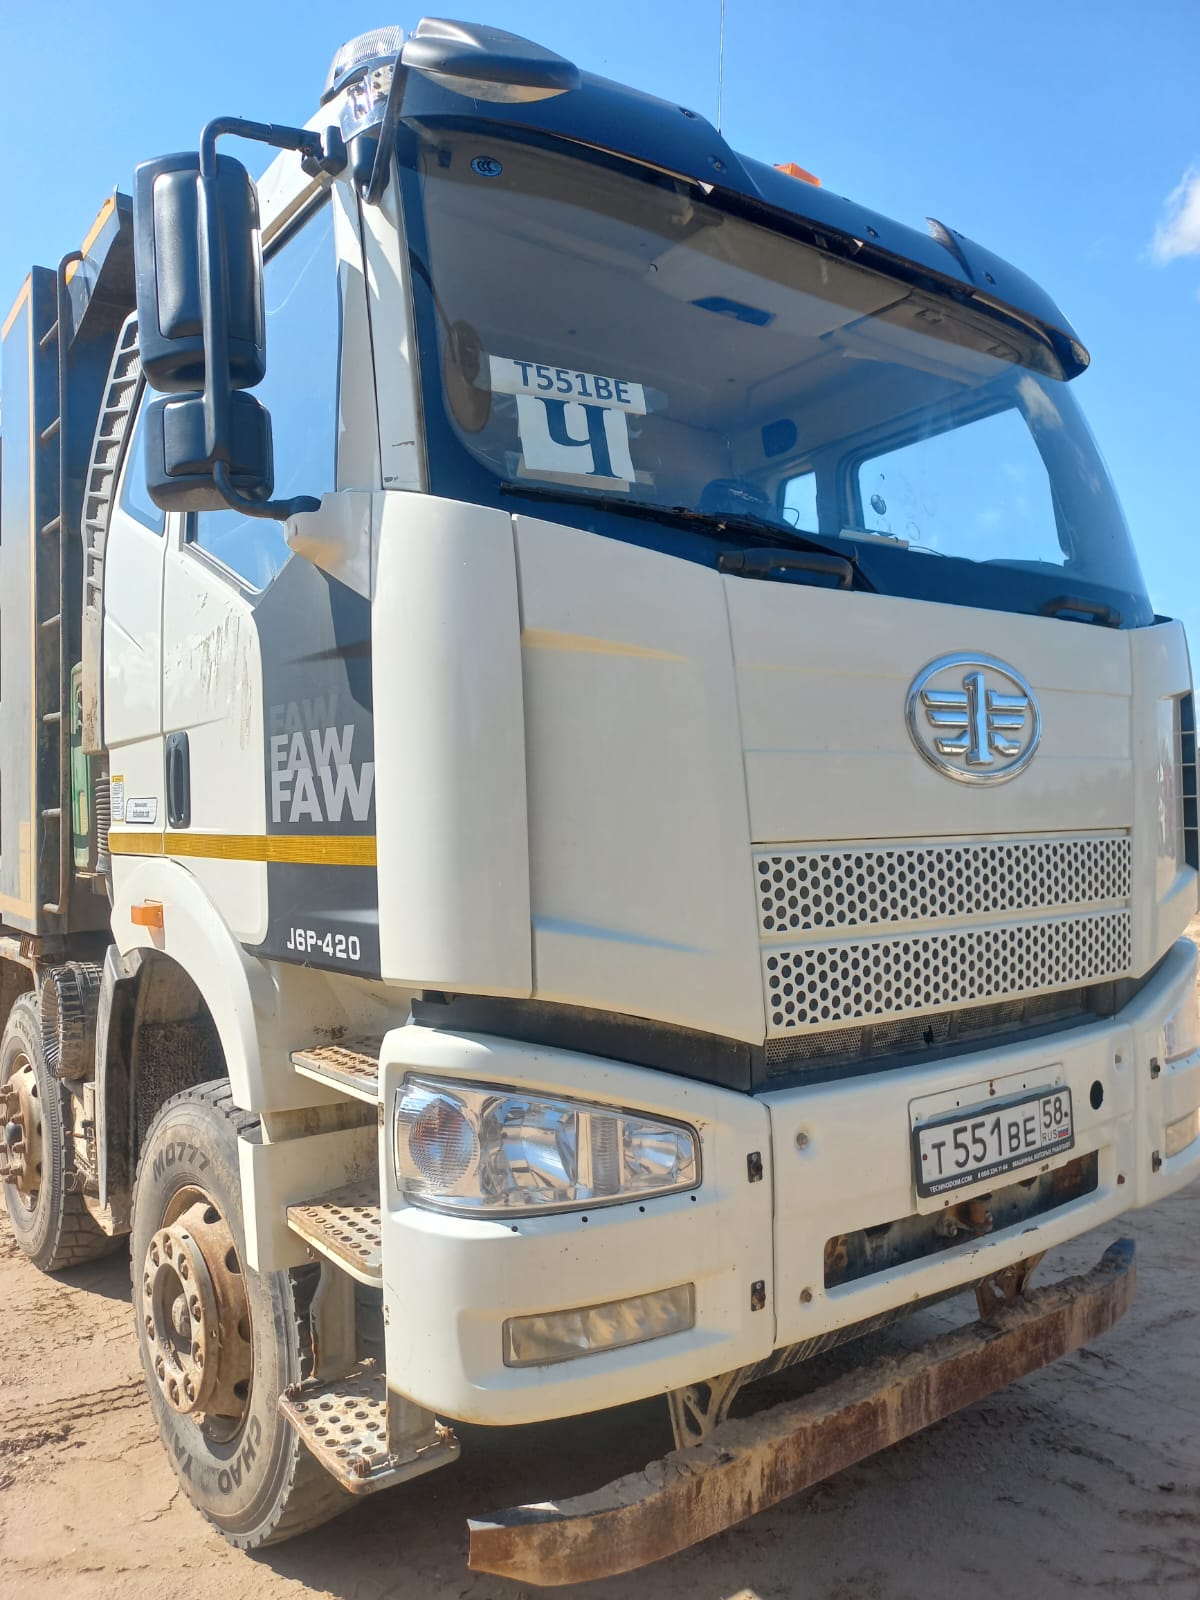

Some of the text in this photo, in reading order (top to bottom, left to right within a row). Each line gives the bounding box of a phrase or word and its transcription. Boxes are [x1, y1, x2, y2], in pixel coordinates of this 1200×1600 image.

[513, 360, 632, 404] T551BE
[269, 694, 339, 736] FAW
[270, 724, 355, 777] FAW
[271, 761, 375, 823] FAW
[286, 927, 361, 961] J6P-420
[931, 1096, 1063, 1175] T551BE 58
[1041, 1129, 1058, 1143] RUS
[217, 1414, 262, 1495] CHAO
